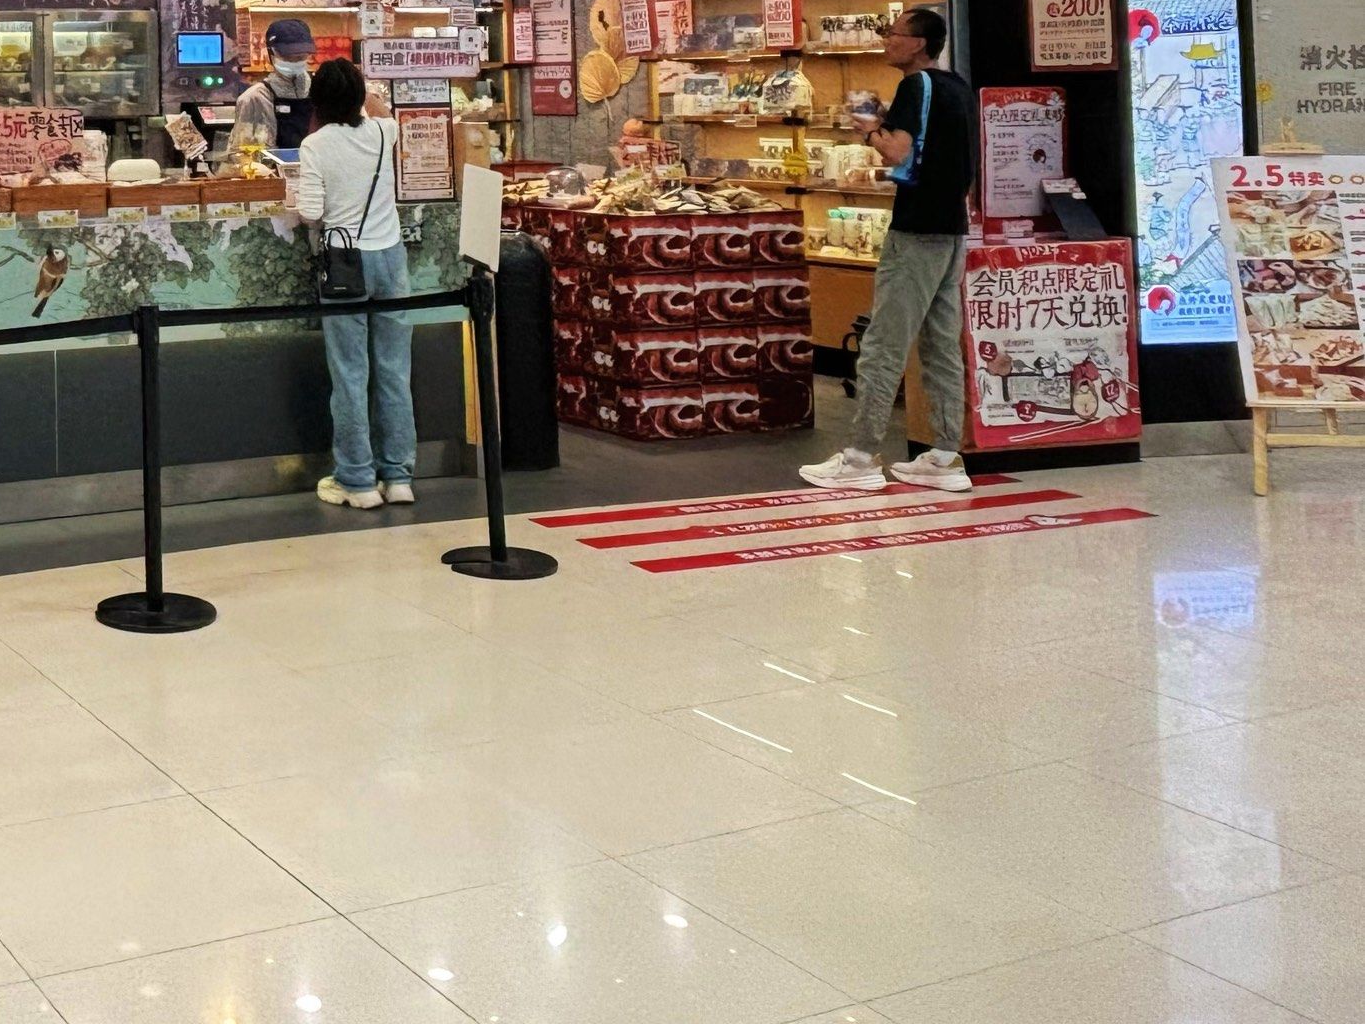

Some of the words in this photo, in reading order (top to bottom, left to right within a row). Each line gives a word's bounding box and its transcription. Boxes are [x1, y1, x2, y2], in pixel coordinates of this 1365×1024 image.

[1318, 82, 1357, 96] FIRE
[970, 264, 1126, 298] 会员积点限定礼
[968, 293, 1128, 330] 限时7天兑换!
